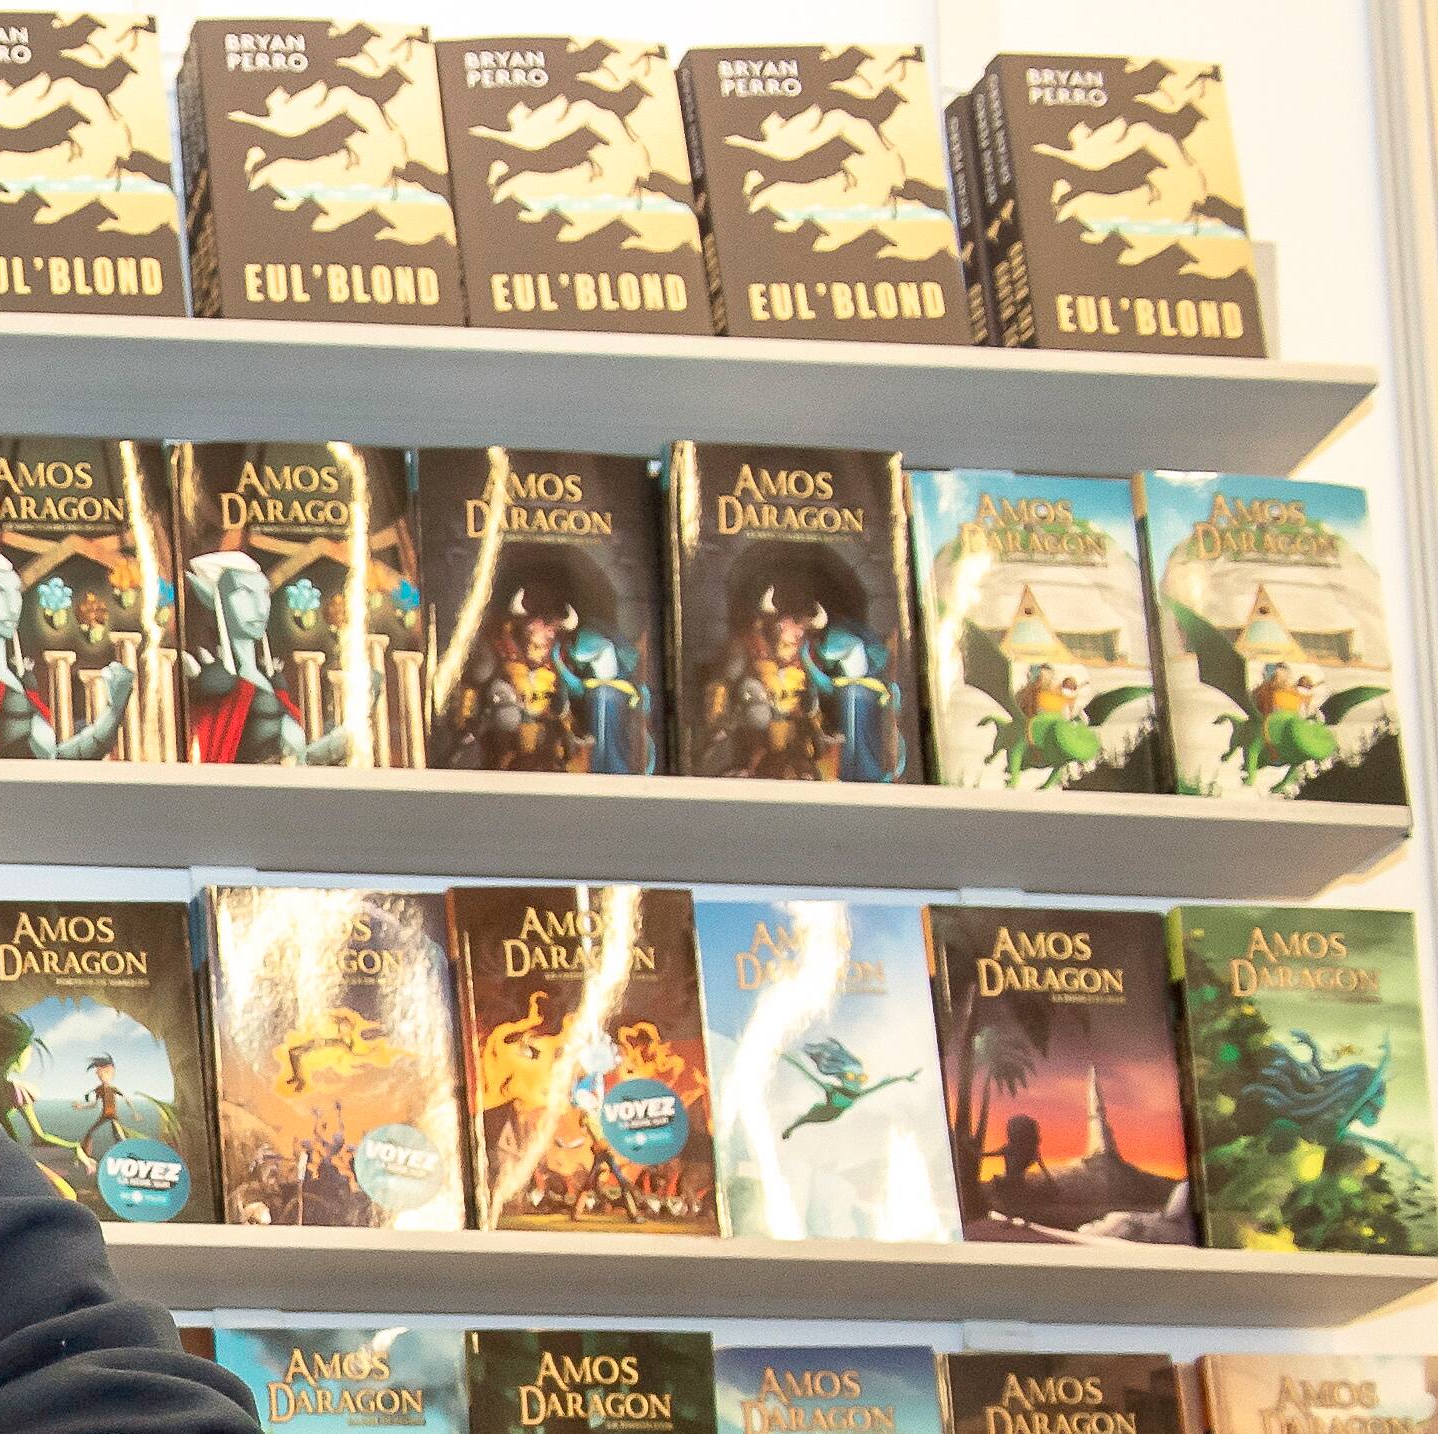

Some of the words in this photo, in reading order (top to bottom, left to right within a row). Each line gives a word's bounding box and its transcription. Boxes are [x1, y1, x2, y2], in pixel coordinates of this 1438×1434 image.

[225, 34, 305, 52] BRYAN
[464, 51, 545, 70] BRYAN
[227, 53, 308, 72] PERRO
[467, 70, 548, 89] PERRO
[718, 60, 798, 79] BRYAN
[1027, 68, 1103, 86] BRYAN
[720, 79, 802, 97] PERRO
[1028, 86, 1107, 107] PERRO
[245, 263, 439, 305] EUL'BLOND
[491, 272, 687, 312] EUL'BLOND
[748, 282, 946, 321] EUL'BLOND
[1056, 295, 1243, 338] EUL'BLOND
[238, 461, 338, 496] AMOS
[482, 468, 583, 503] AMOS
[734, 464, 833, 502] AMOS
[221, 493, 363, 531] DARAGO
[718, 495, 864, 535] DARAGON
[976, 492, 1073, 527] AMOS
[1207, 493, 1307, 528] AMOS
[1195, 522, 1340, 560] DARAGON
[12, 912, 115, 949] AMOS
[992, 927, 1091, 963] AMOS
[1247, 927, 1347, 961] AMOS
[977, 958, 1123, 997] DARAGON
[1230, 959, 1380, 997] DARAGON
[604, 1096, 675, 1122] VOYEZ
[106, 1157, 182, 1181] VOYEZ
[284, 1348, 390, 1386] AMOS
[535, 1352, 639, 1391] AMOS
[757, 1366, 861, 1405] AMOS
[268, 1382, 423, 1422] DARAGON
[519, 1385, 671, 1425] DARAGON
[1001, 1372, 1103, 1410] AMOS
